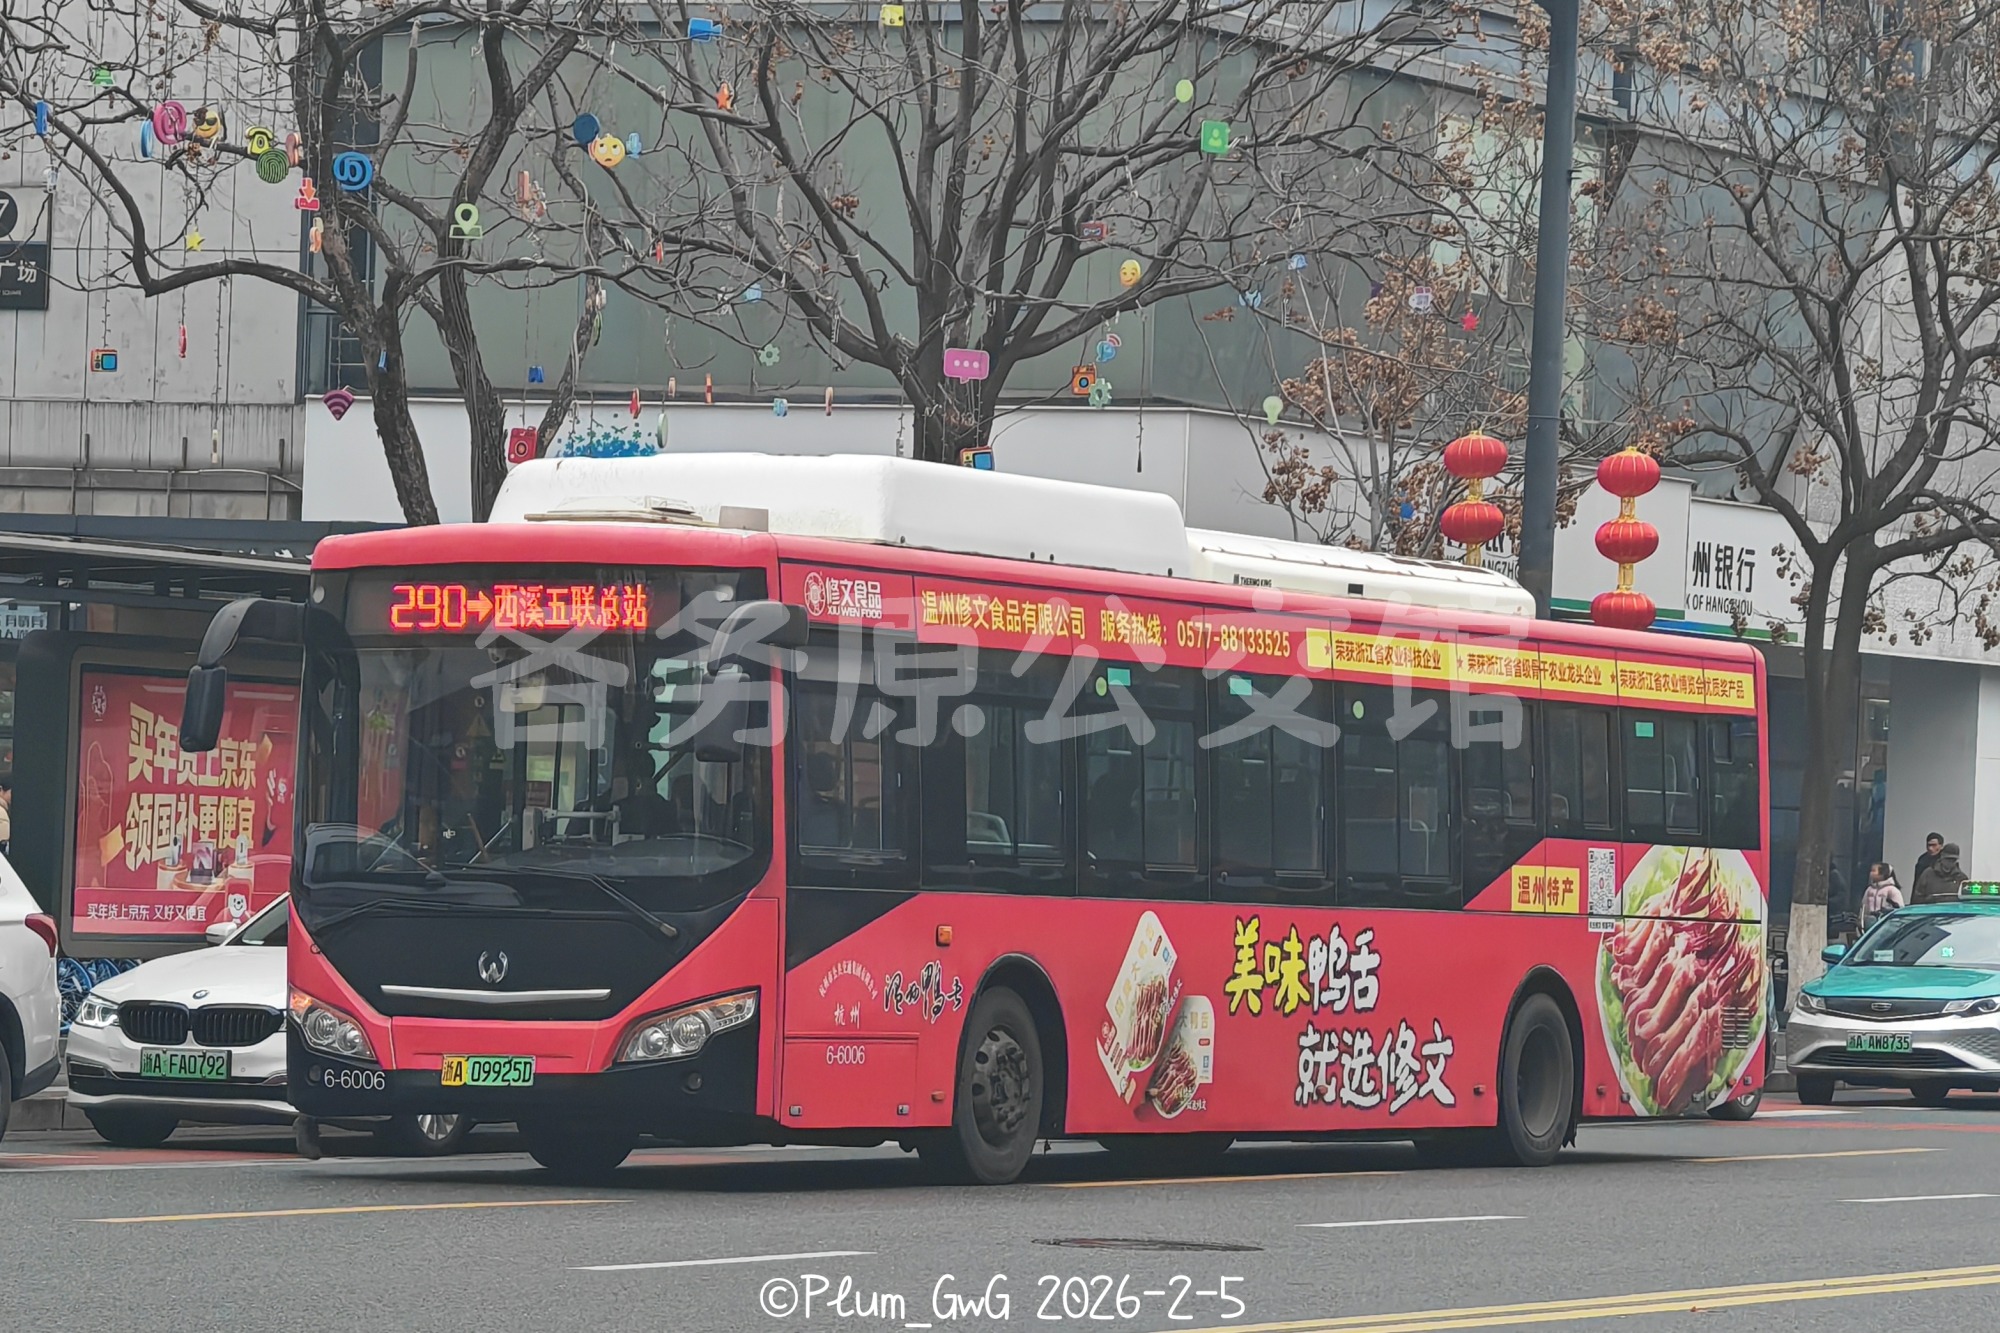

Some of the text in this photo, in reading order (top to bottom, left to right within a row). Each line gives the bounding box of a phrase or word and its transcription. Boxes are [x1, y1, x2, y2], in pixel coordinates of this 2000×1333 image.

[1692, 541, 1755, 593] 州银行
[391, 584, 648, 629] 290 西溪五联总站
[825, 577, 882, 609] 修文食品
[1692, 594, 1704, 610] OF
[827, 606, 882, 619] XIU WEN FOOD
[921, 590, 1086, 641] 温州修文食品有限公司
[1177, 620, 1291, 658] 0577-88133525
[1335, 639, 1442, 671] 荣获浙江省农业科技企业
[1518, 876, 1574, 907] 温州特产
[87, 903, 206, 921] 买年货上京东 又好又便宜
[1224, 915, 1381, 1016] 美味鸭舌
[834, 1001, 860, 1029] 杭州
[826, 1045, 865, 1064] 6-6006
[1294, 1018, 1456, 1115] 就选修文
[323, 1069, 385, 1090] 6-6006
